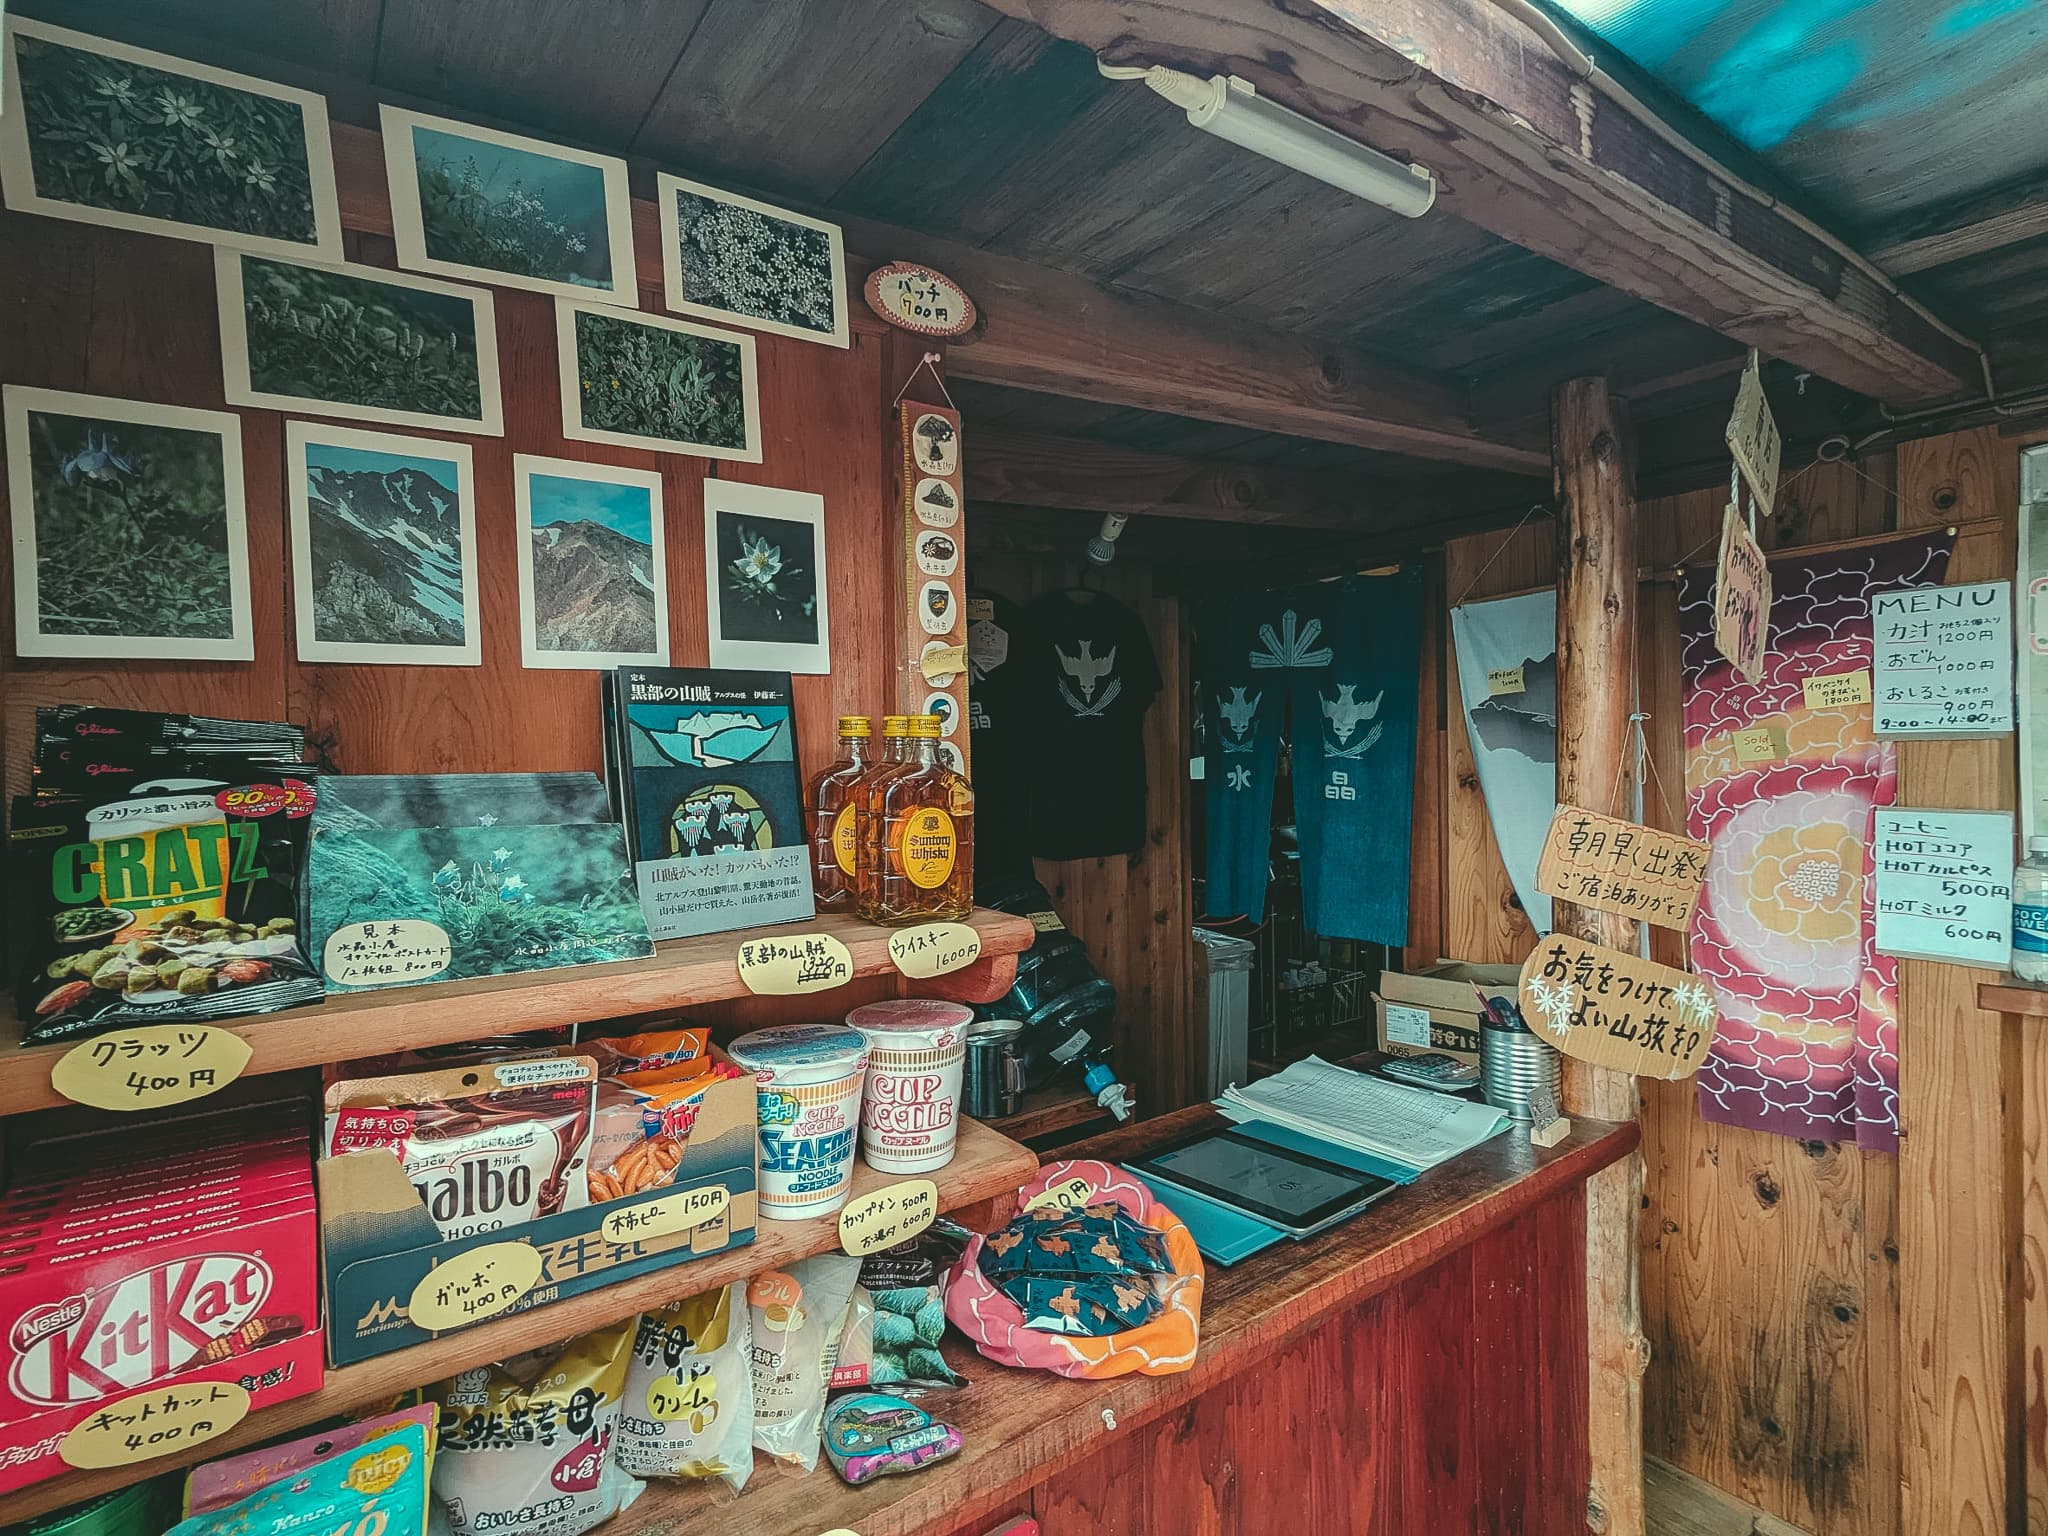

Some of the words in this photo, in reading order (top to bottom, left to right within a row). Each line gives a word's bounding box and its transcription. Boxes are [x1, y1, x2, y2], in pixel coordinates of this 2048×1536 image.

[898, 277, 940, 303] バッチ
[902, 298, 948, 321] 700円
[1877, 589, 1996, 616] MENU
[1888, 619, 1934, 640] 力汁
[1938, 630, 1994, 646] 1200円
[1888, 648, 1946, 668] おでん
[1936, 660, 1994, 674] 1000円
[631, 684, 711, 702] 黒部の山賊
[1825, 694, 1861, 706] 1800円
[1886, 685, 1950, 701] おしるこ
[1943, 700, 1994, 714] 900円
[1744, 734, 1769, 745] Sold
[1227, 764, 1251, 792] 水
[1325, 771, 1356, 801] 晶
[98, 800, 214, 822] カリッと濃い旨み
[1888, 820, 1948, 834] コーヒー
[909, 834, 951, 849] Suntory
[52, 821, 268, 904] CRATZ
[910, 848, 950, 863] Whisky
[1556, 871, 1689, 920] ご宿泊ありがとう
[1942, 881, 2010, 900] 500円
[363, 923, 407, 939] 見本
[1945, 924, 2002, 943] 600円
[337, 939, 400, 953] 水晶小屋
[741, 937, 828, 969] 黒部の山賊
[892, 931, 950, 960] ウイスキー
[935, 943, 978, 970] 1600円
[341, 964, 400, 980] 12枚組
[91, 1031, 209, 1067] クラッツ
[125, 1068, 216, 1097] 400円
[871, 1074, 942, 1105] CUP
[552, 1088, 586, 1100] meiji
[344, 1117, 388, 1129] 気持ち
[805, 1105, 839, 1122] CUP
[338, 1134, 401, 1148] 切りかえ
[798, 1165, 838, 1182] NOODLE
[609, 1206, 666, 1236] 柿ピー
[684, 1190, 722, 1214] 150円
[843, 1199, 896, 1229] カップメン
[902, 1191, 929, 1211] 500円
[902, 1207, 931, 1230] 600円
[56, 1234, 93, 1246] Have
[106, 1222, 149, 1235] break,
[151, 1214, 182, 1225] have
[441, 1219, 503, 1240] HOCO
[49, 1251, 86, 1264] Have
[101, 1240, 144, 1253] break,
[147, 1229, 179, 1242] have
[435, 1261, 496, 1306] ガルボ
[463, 1284, 518, 1315] 400円
[50, 1258, 256, 1402] KitKat
[86, 1386, 229, 1432] キットカット
[447, 1393, 488, 1407] D-PLUS
[653, 1388, 709, 1414] クリーム
[125, 1421, 213, 1451] 400円
[271, 1504, 335, 1535] Kanro
[475, 1495, 575, 1530] おいしさ長持ち
